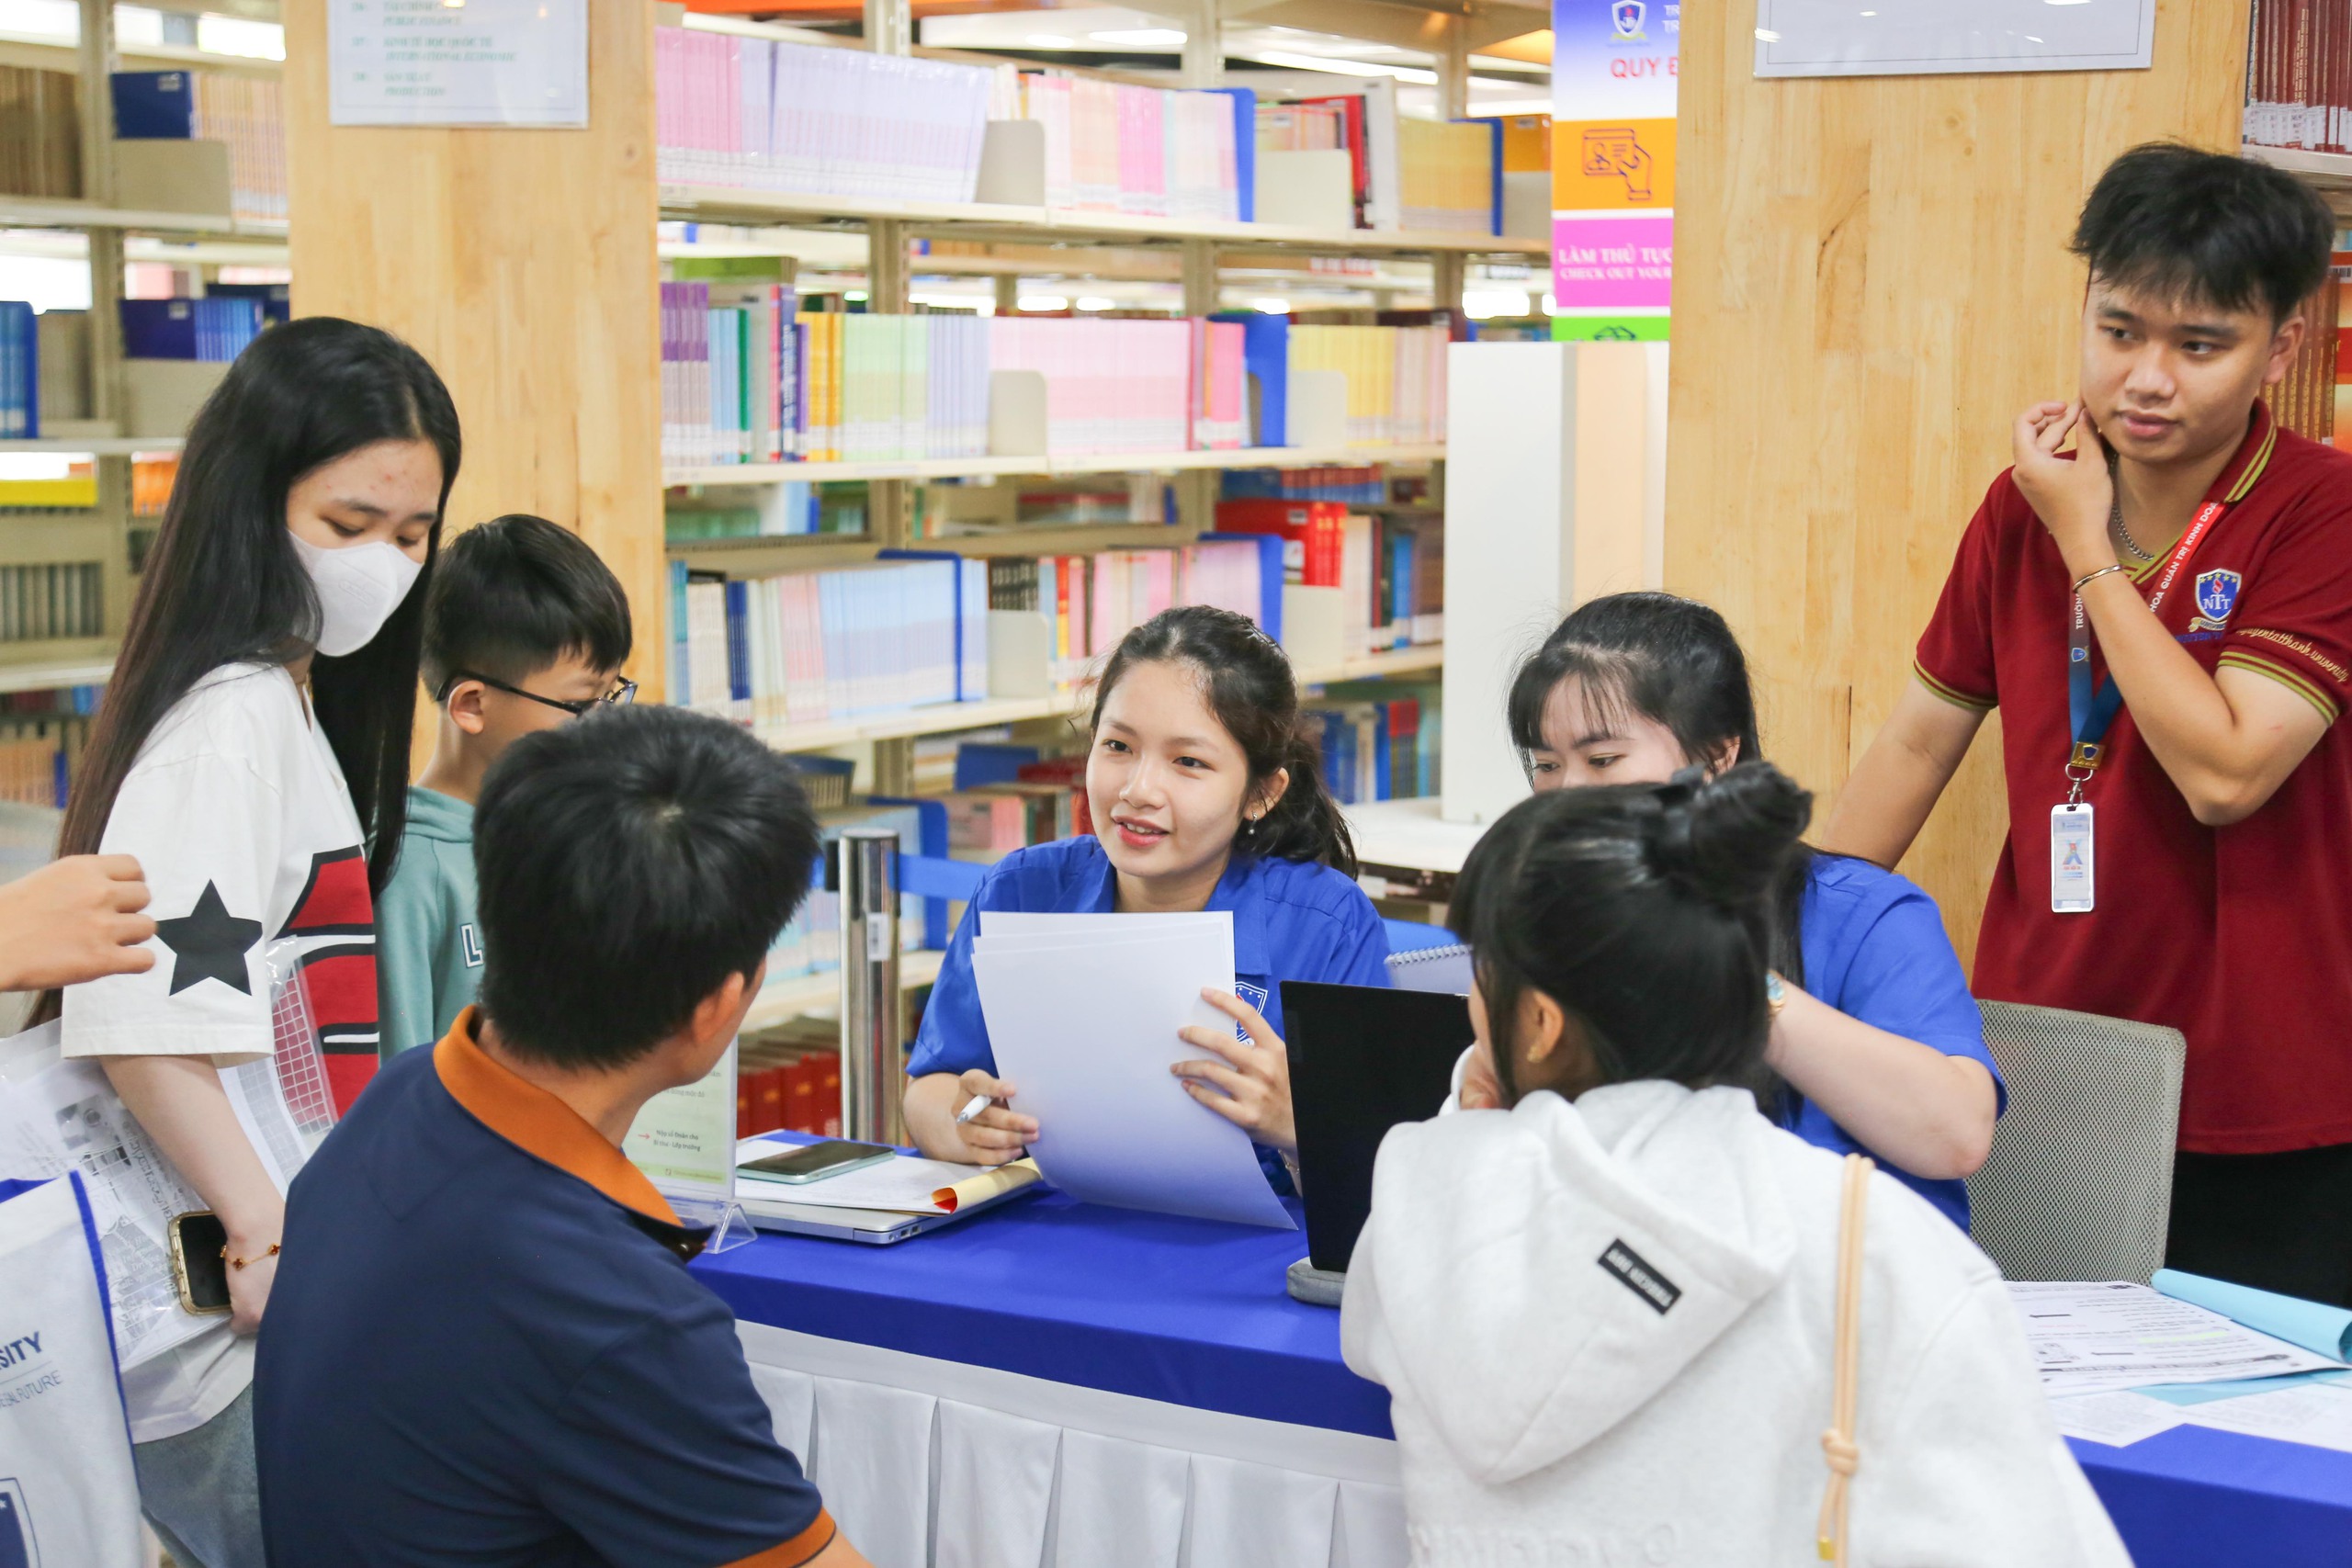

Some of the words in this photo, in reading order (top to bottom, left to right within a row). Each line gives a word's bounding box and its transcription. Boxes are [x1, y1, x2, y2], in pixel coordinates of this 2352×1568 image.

[1610, 57, 1661, 79] QUY
[2160, 560, 2180, 590] QUẢN
[2175, 546, 2191, 565] TRỊ
[2185, 522, 2203, 546] KINH
